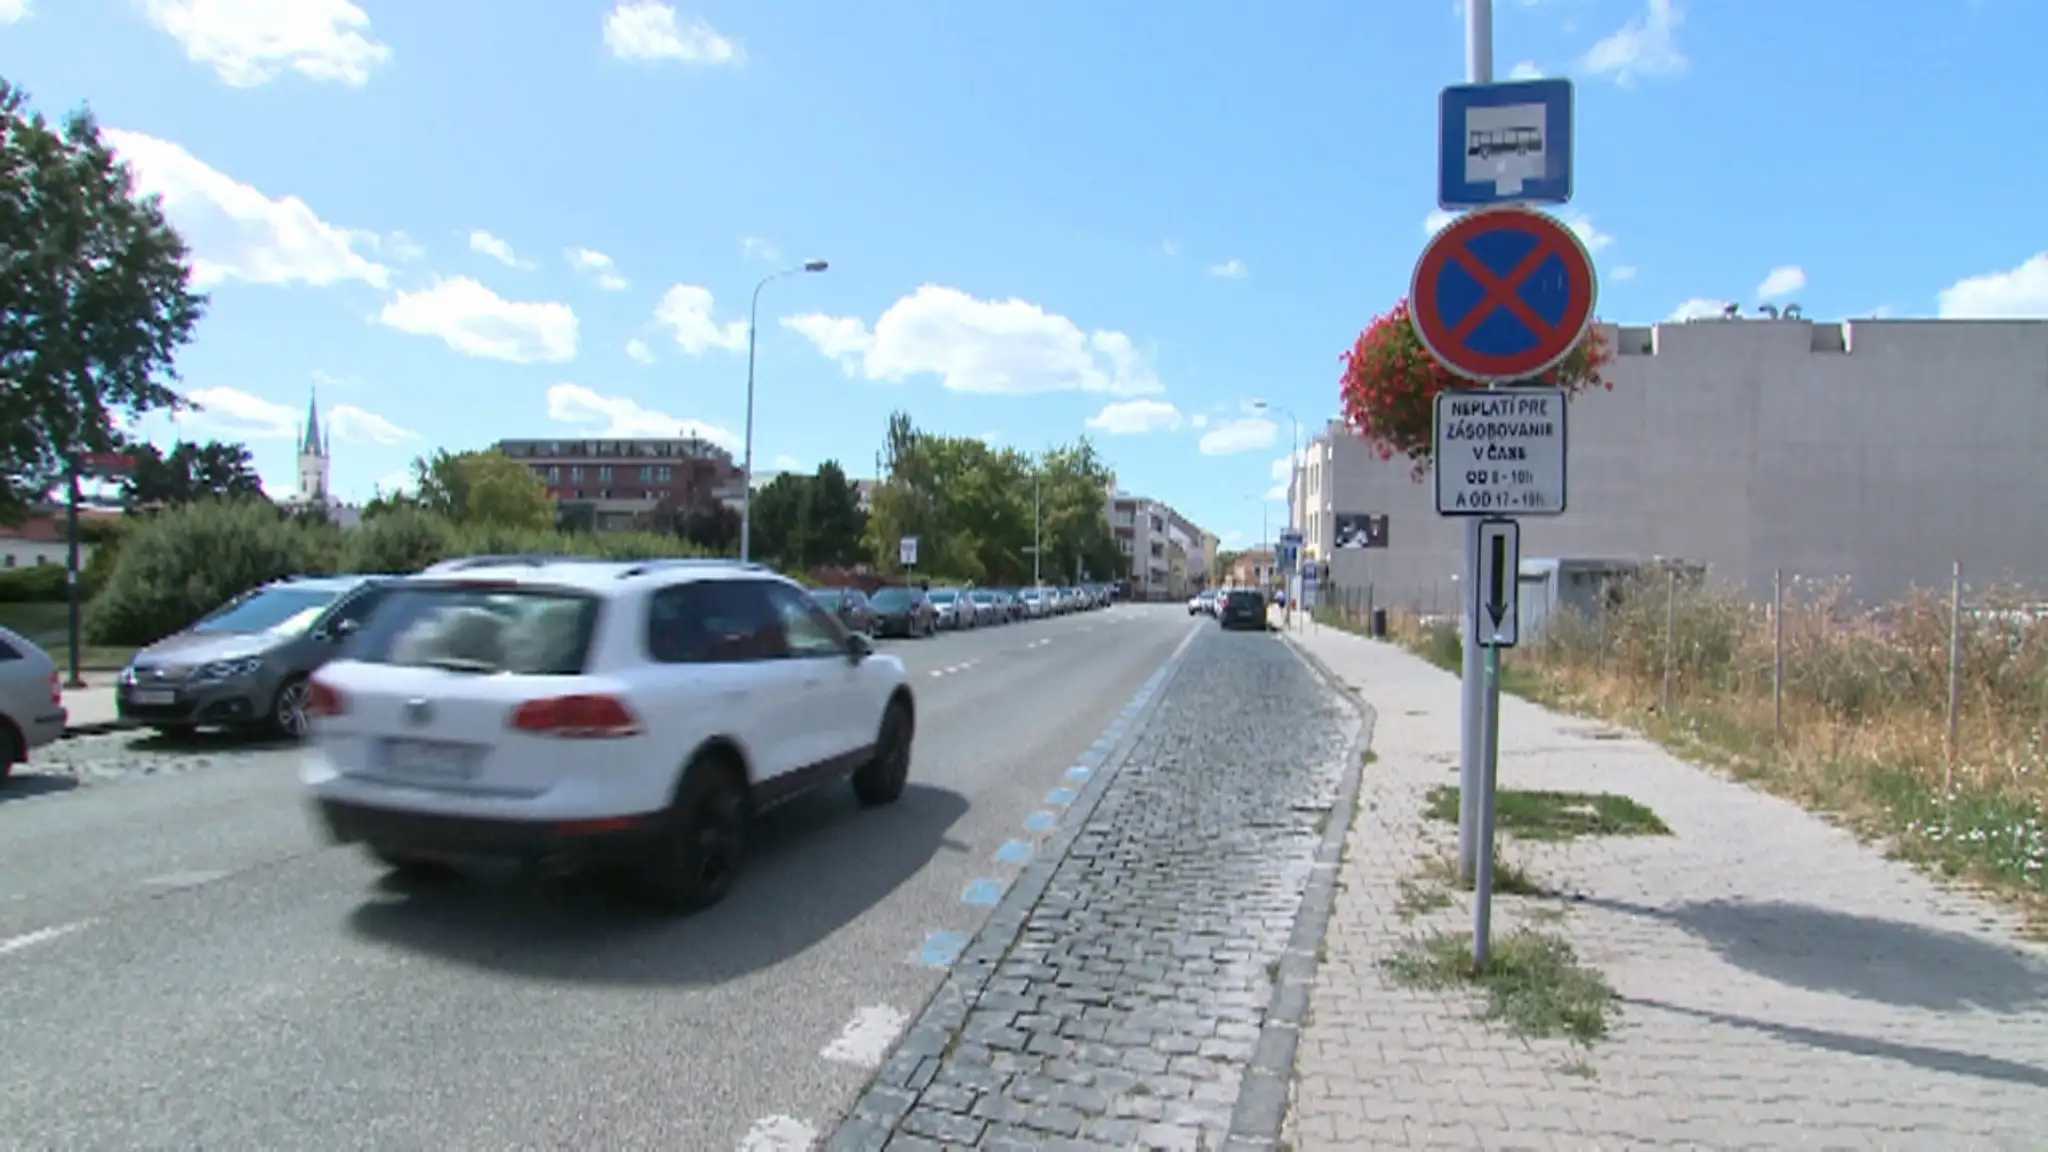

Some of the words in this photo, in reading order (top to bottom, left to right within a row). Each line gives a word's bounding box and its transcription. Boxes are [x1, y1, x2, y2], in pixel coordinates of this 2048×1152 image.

[1452, 396, 1514, 416] NEPLATÍ
[1519, 399, 1548, 415] PRE
[1446, 420, 1553, 439] ZÁSOBOVANIE
[1472, 447, 1484, 460] V
[1487, 443, 1527, 460] ČASE
[1466, 470, 1488, 485] OD
[1456, 492, 1466, 508] A
[1470, 491, 1491, 507] OD
